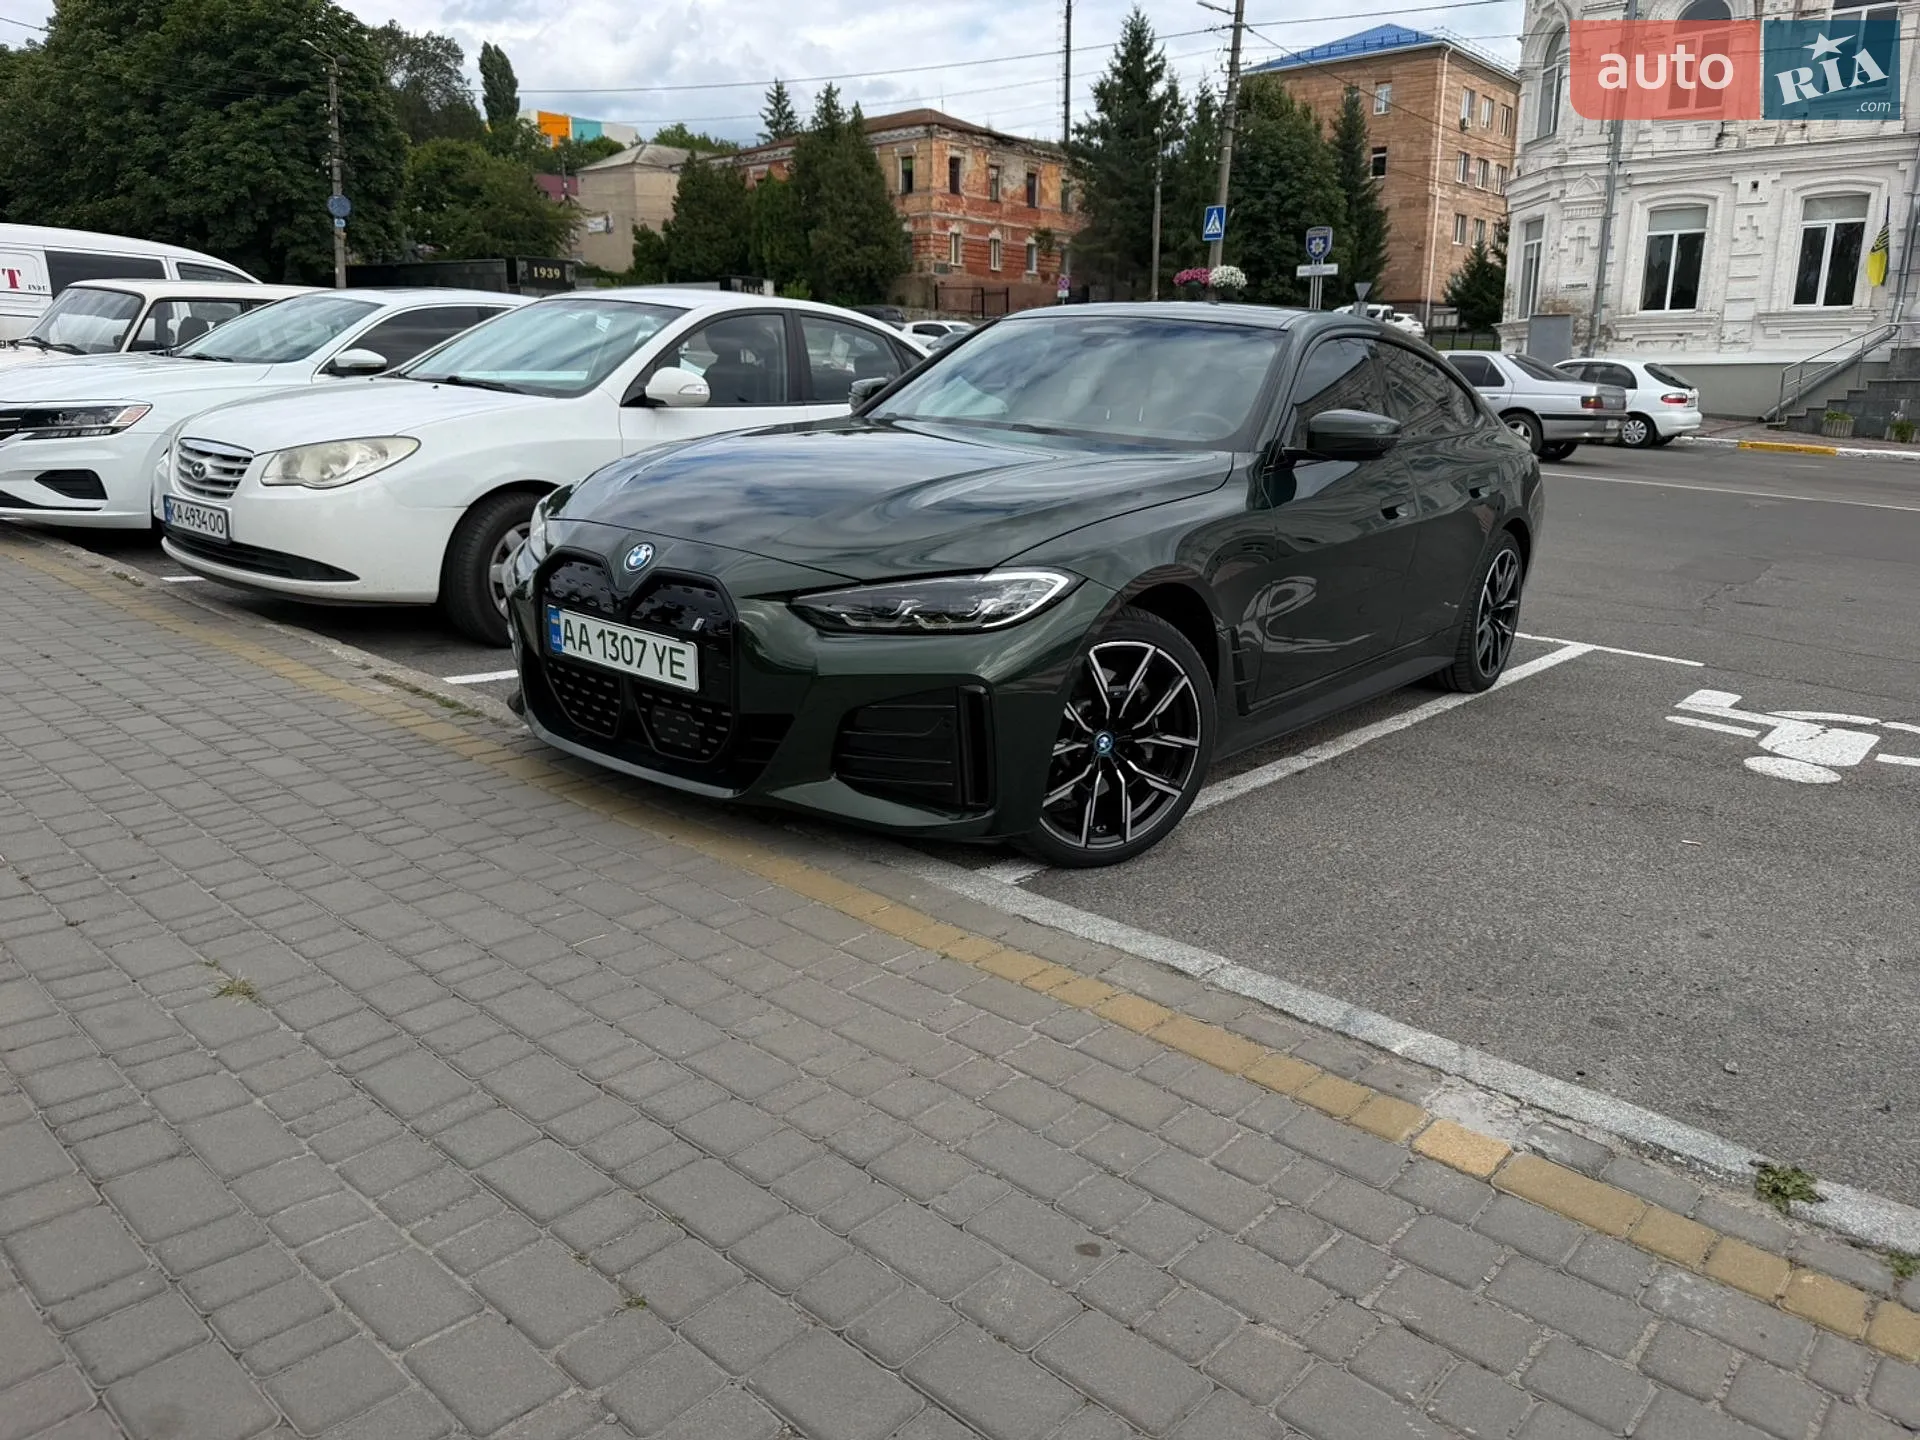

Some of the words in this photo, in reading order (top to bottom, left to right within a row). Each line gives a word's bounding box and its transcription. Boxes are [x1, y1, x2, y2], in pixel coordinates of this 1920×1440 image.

[533, 266, 561, 280] 1939
[185, 506, 208, 530] 4934
[563, 619, 592, 655] AA
[596, 628, 648, 668] 1307
[653, 642, 687, 681] YE
